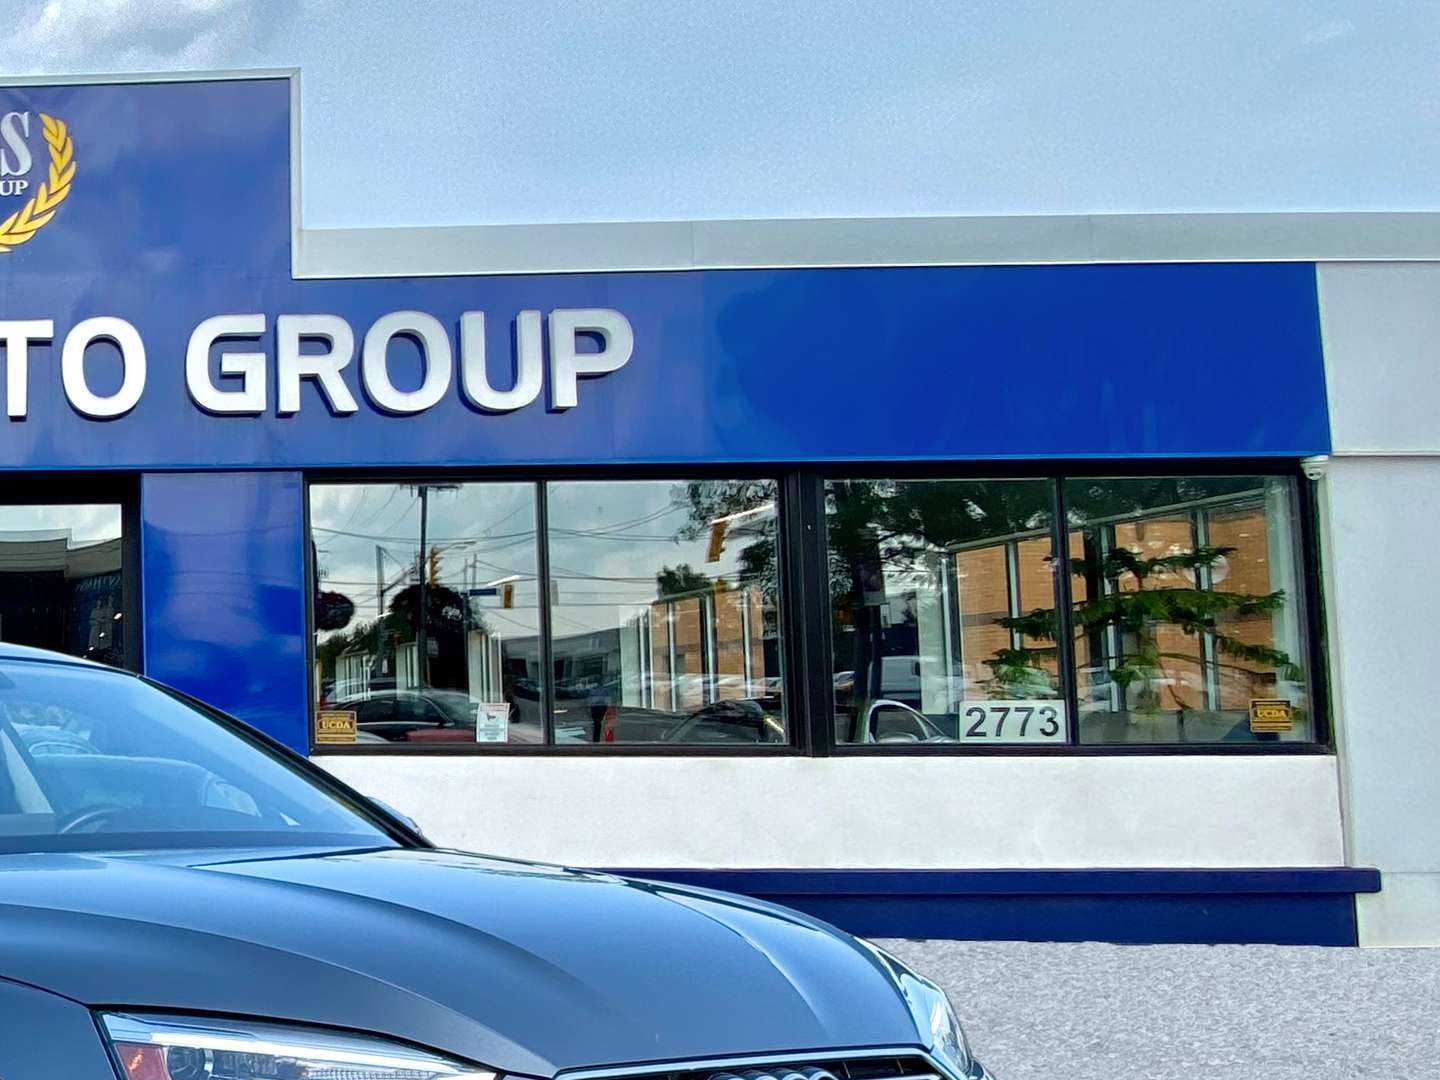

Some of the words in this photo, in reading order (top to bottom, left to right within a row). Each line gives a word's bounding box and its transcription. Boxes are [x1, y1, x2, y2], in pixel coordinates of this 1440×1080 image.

[185, 308, 634, 415] GROUP
[321, 720, 350, 729] UCDA
[966, 706, 1059, 737] 2773
